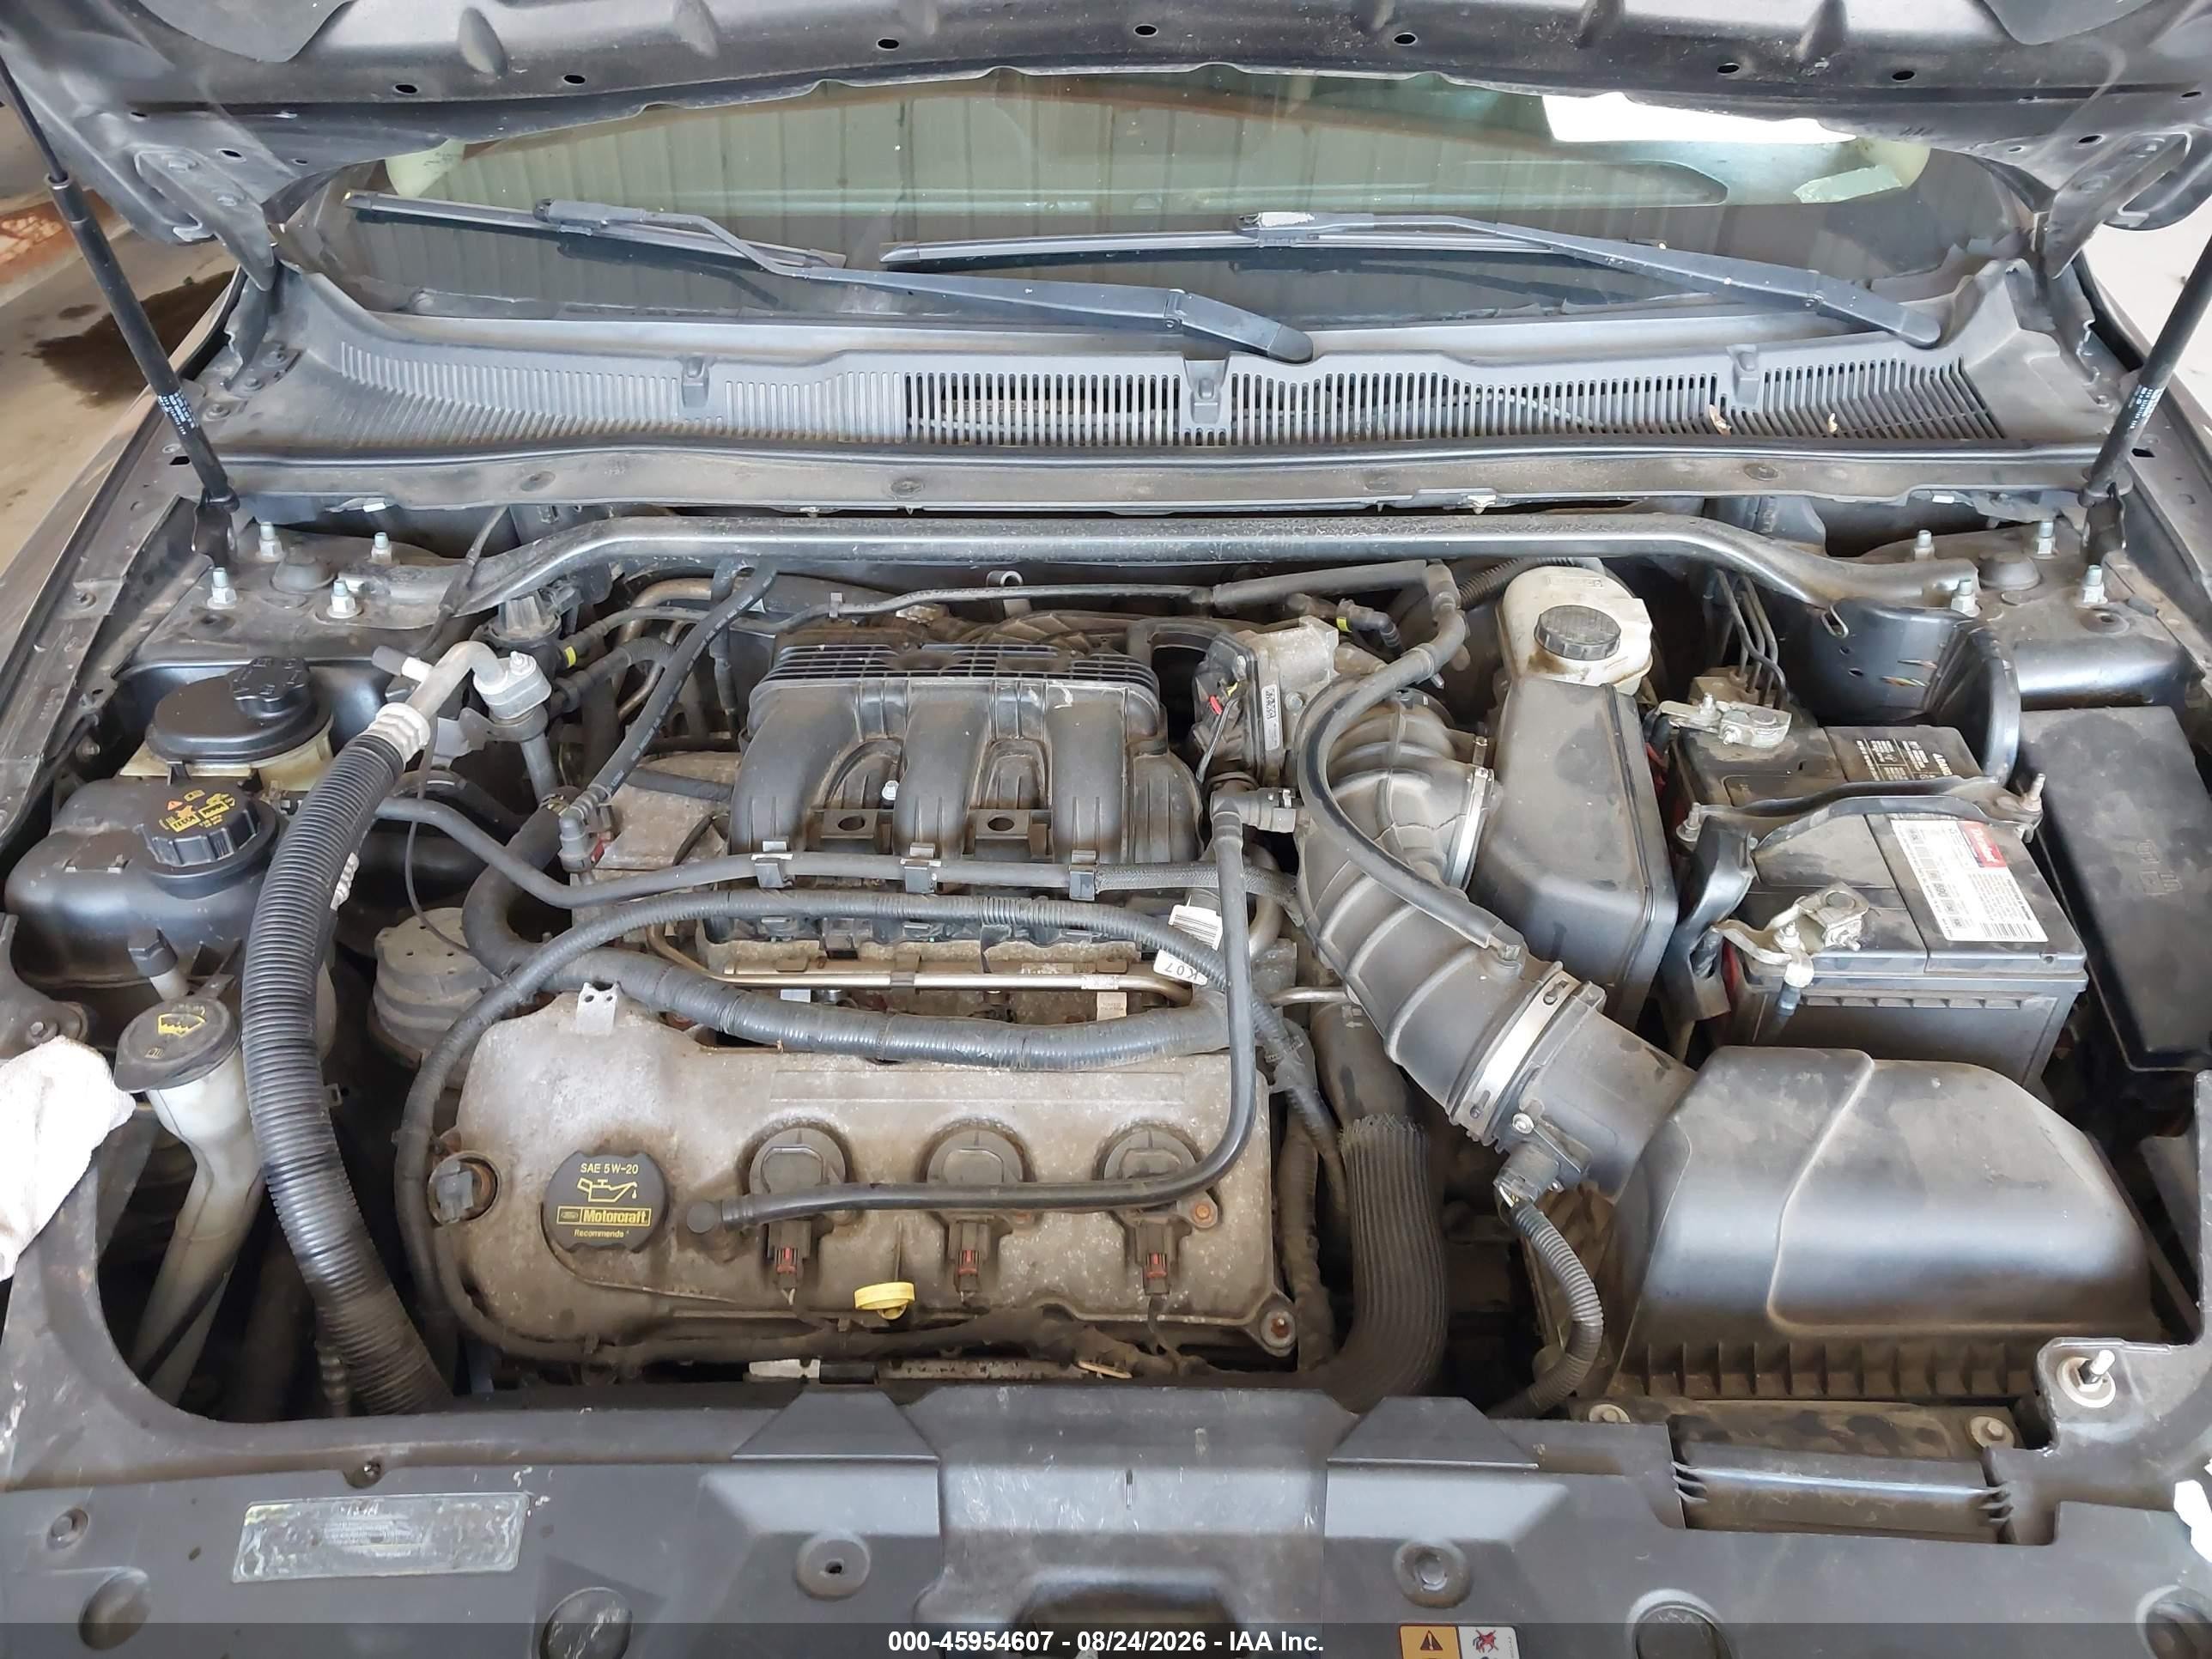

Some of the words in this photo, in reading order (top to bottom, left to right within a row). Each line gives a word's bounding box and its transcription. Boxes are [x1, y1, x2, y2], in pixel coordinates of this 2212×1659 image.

[580, 1163, 601, 1174] SAE
[604, 1164, 639, 1175] 5W-20
[583, 1209, 647, 1224] Motorcraft
